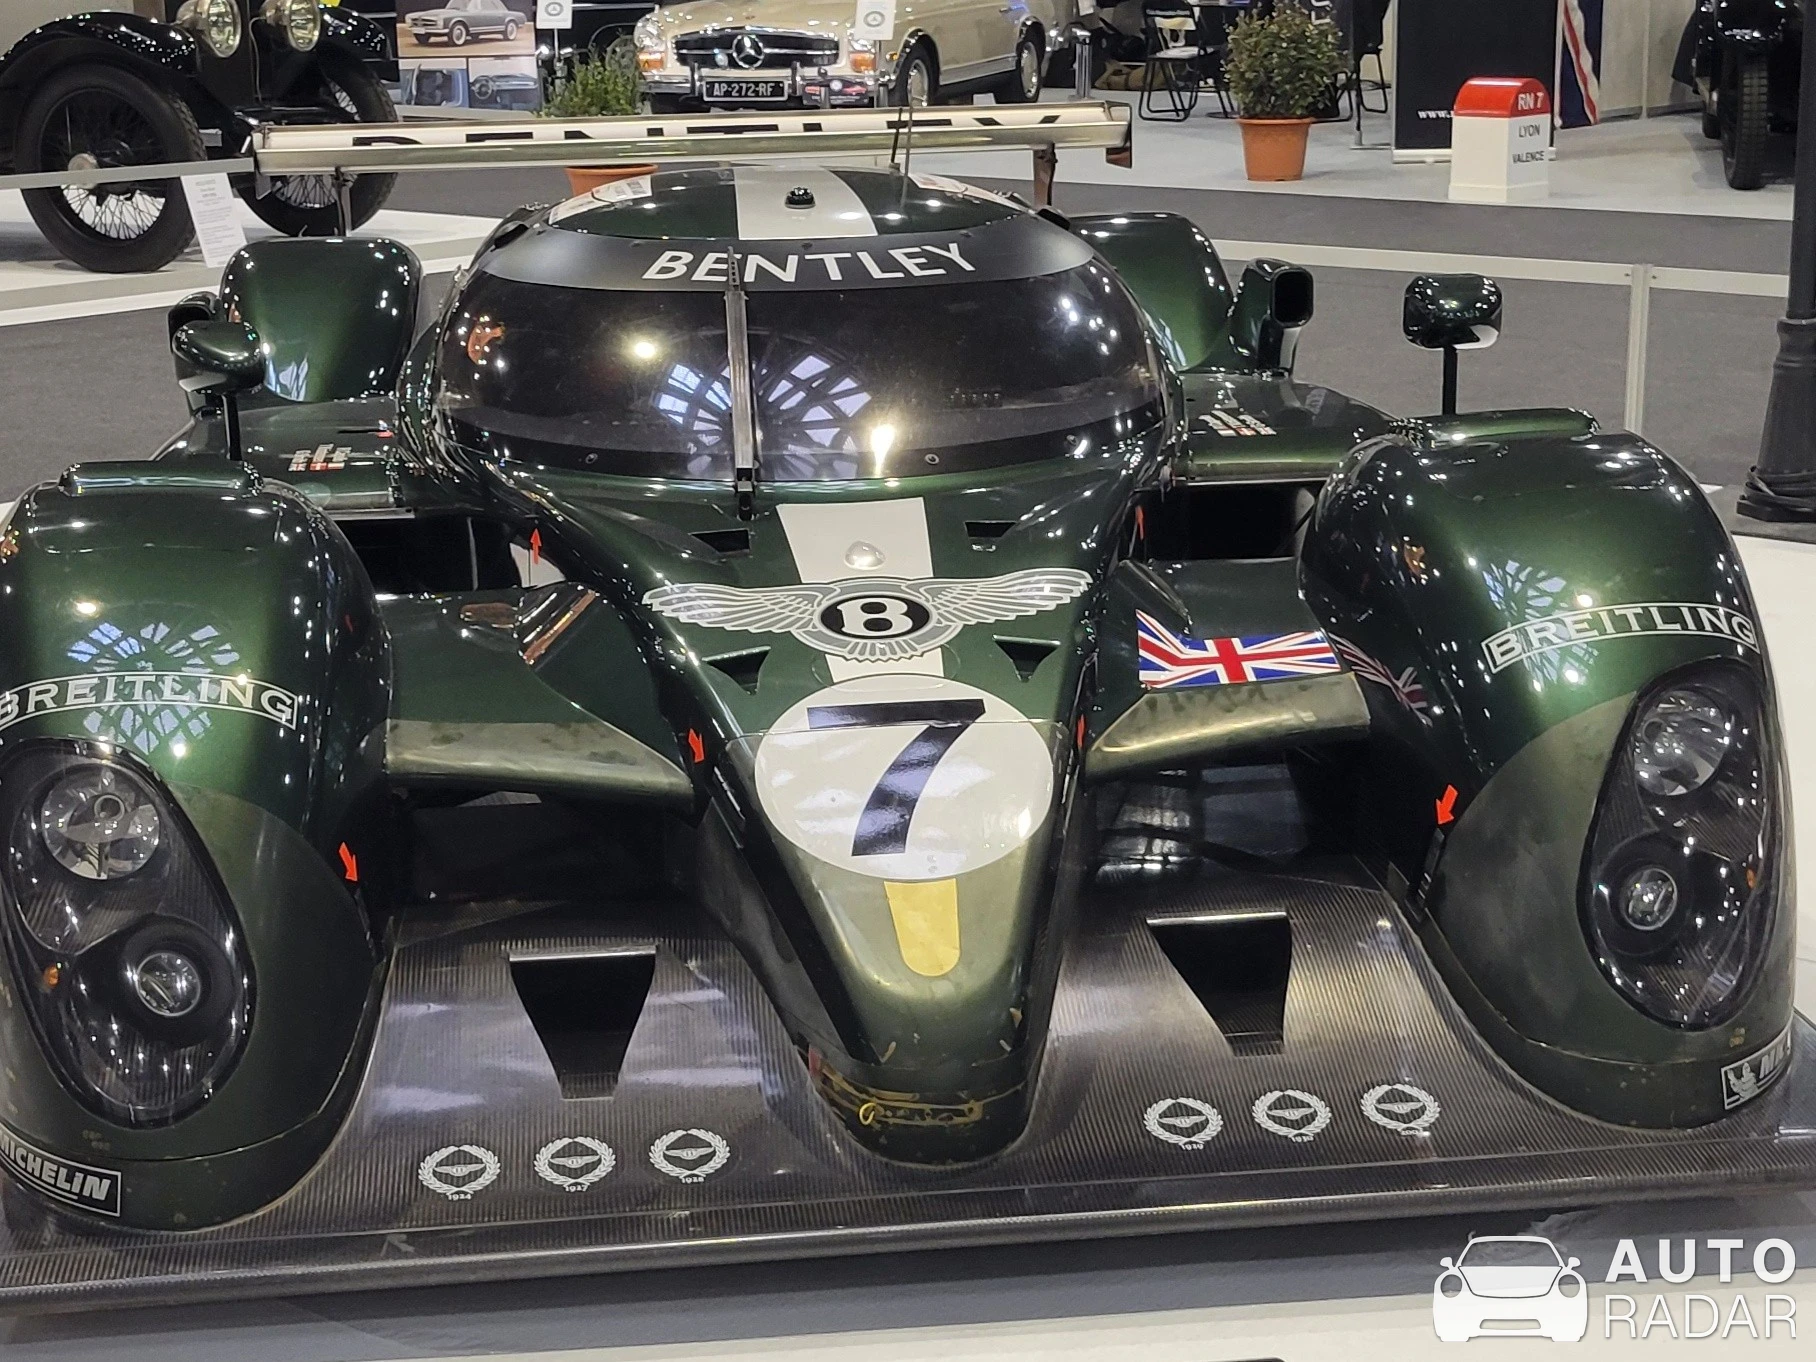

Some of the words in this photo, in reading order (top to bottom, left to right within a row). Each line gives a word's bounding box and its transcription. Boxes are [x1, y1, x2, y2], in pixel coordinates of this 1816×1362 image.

[713, 83, 775, 97] AP-272-RF
[1518, 92, 1535, 110] RN
[1536, 91, 1544, 109] 7
[1418, 110, 1454, 118] www.
[1518, 124, 1541, 138] LYON
[1512, 151, 1545, 164] VALENCE
[642, 243, 976, 283] BENTLEY
[836, 597, 913, 636] B
[1488, 607, 1756, 666] BREITLING
[0, 675, 294, 726] BREITLING
[806, 698, 986, 857] 7
